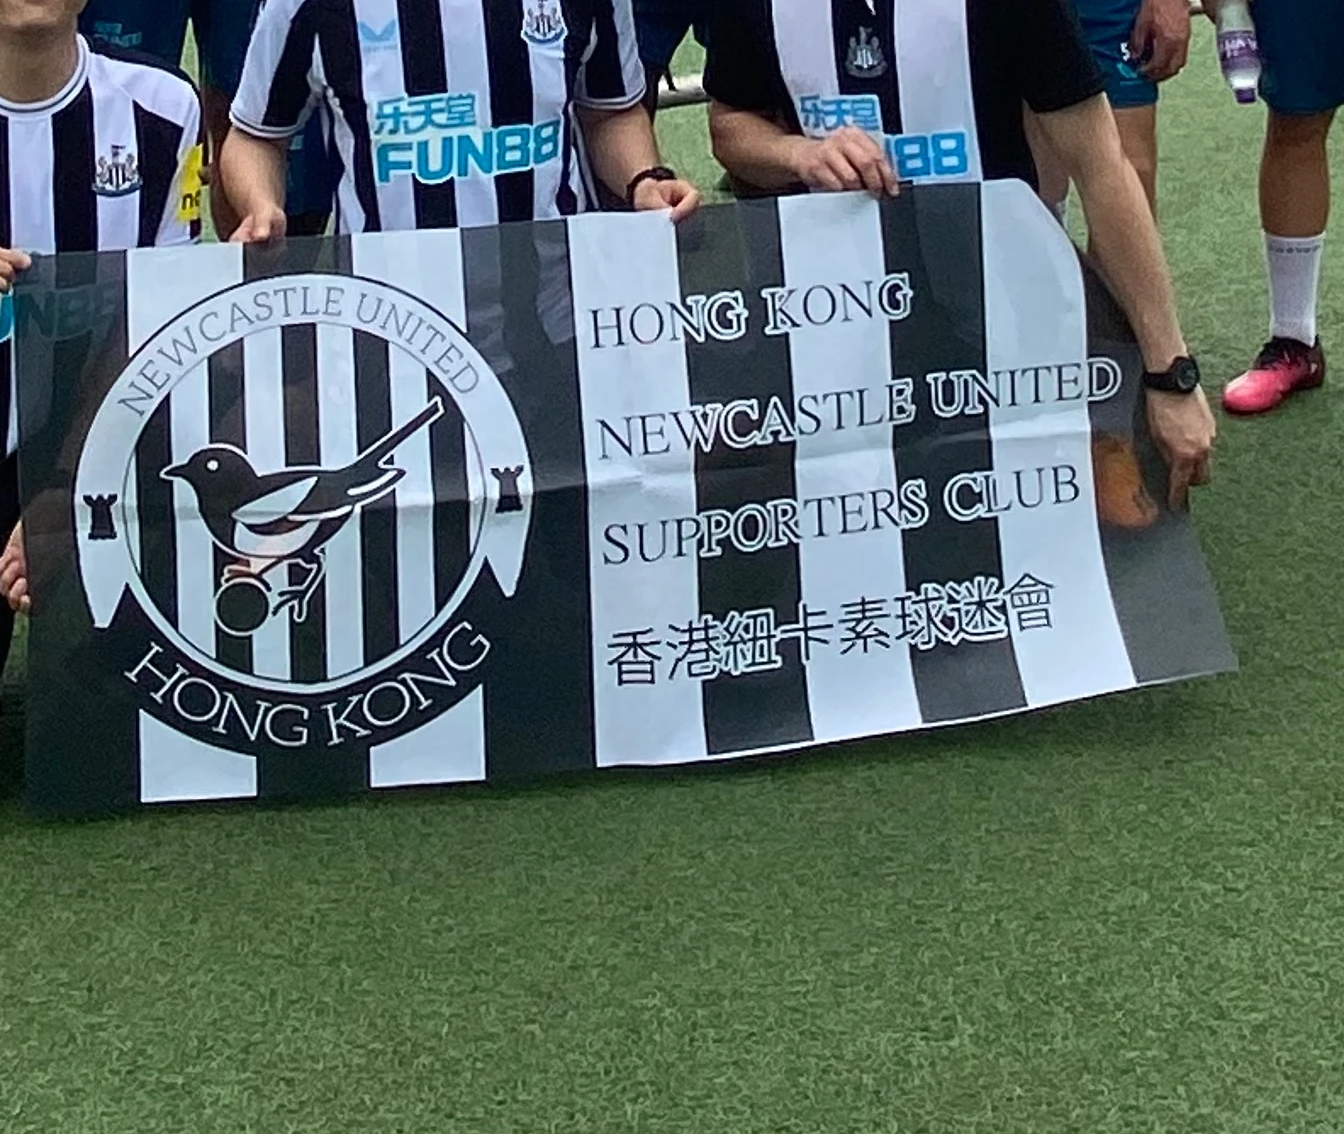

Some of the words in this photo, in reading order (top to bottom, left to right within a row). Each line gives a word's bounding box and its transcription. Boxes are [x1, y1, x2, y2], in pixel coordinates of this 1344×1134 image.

[374, 93, 477, 136] 乐天堂
[375, 118, 561, 185] FUN88
[118, 285, 343, 418] NEWCASTLE
[356, 292, 481, 397] UNITED
[588, 290, 748, 350] HONG
[762, 271, 913, 336] KONG
[596, 378, 916, 462] NEWCASTLE
[926, 357, 1122, 418] UNITED
[602, 479, 927, 566] SUPPORTERS
[944, 463, 1081, 522] CLUB
[607, 571, 1057, 688] 香港紐卡素球迷會
[123, 641, 310, 747] HONG
[326, 620, 492, 747] KONG
